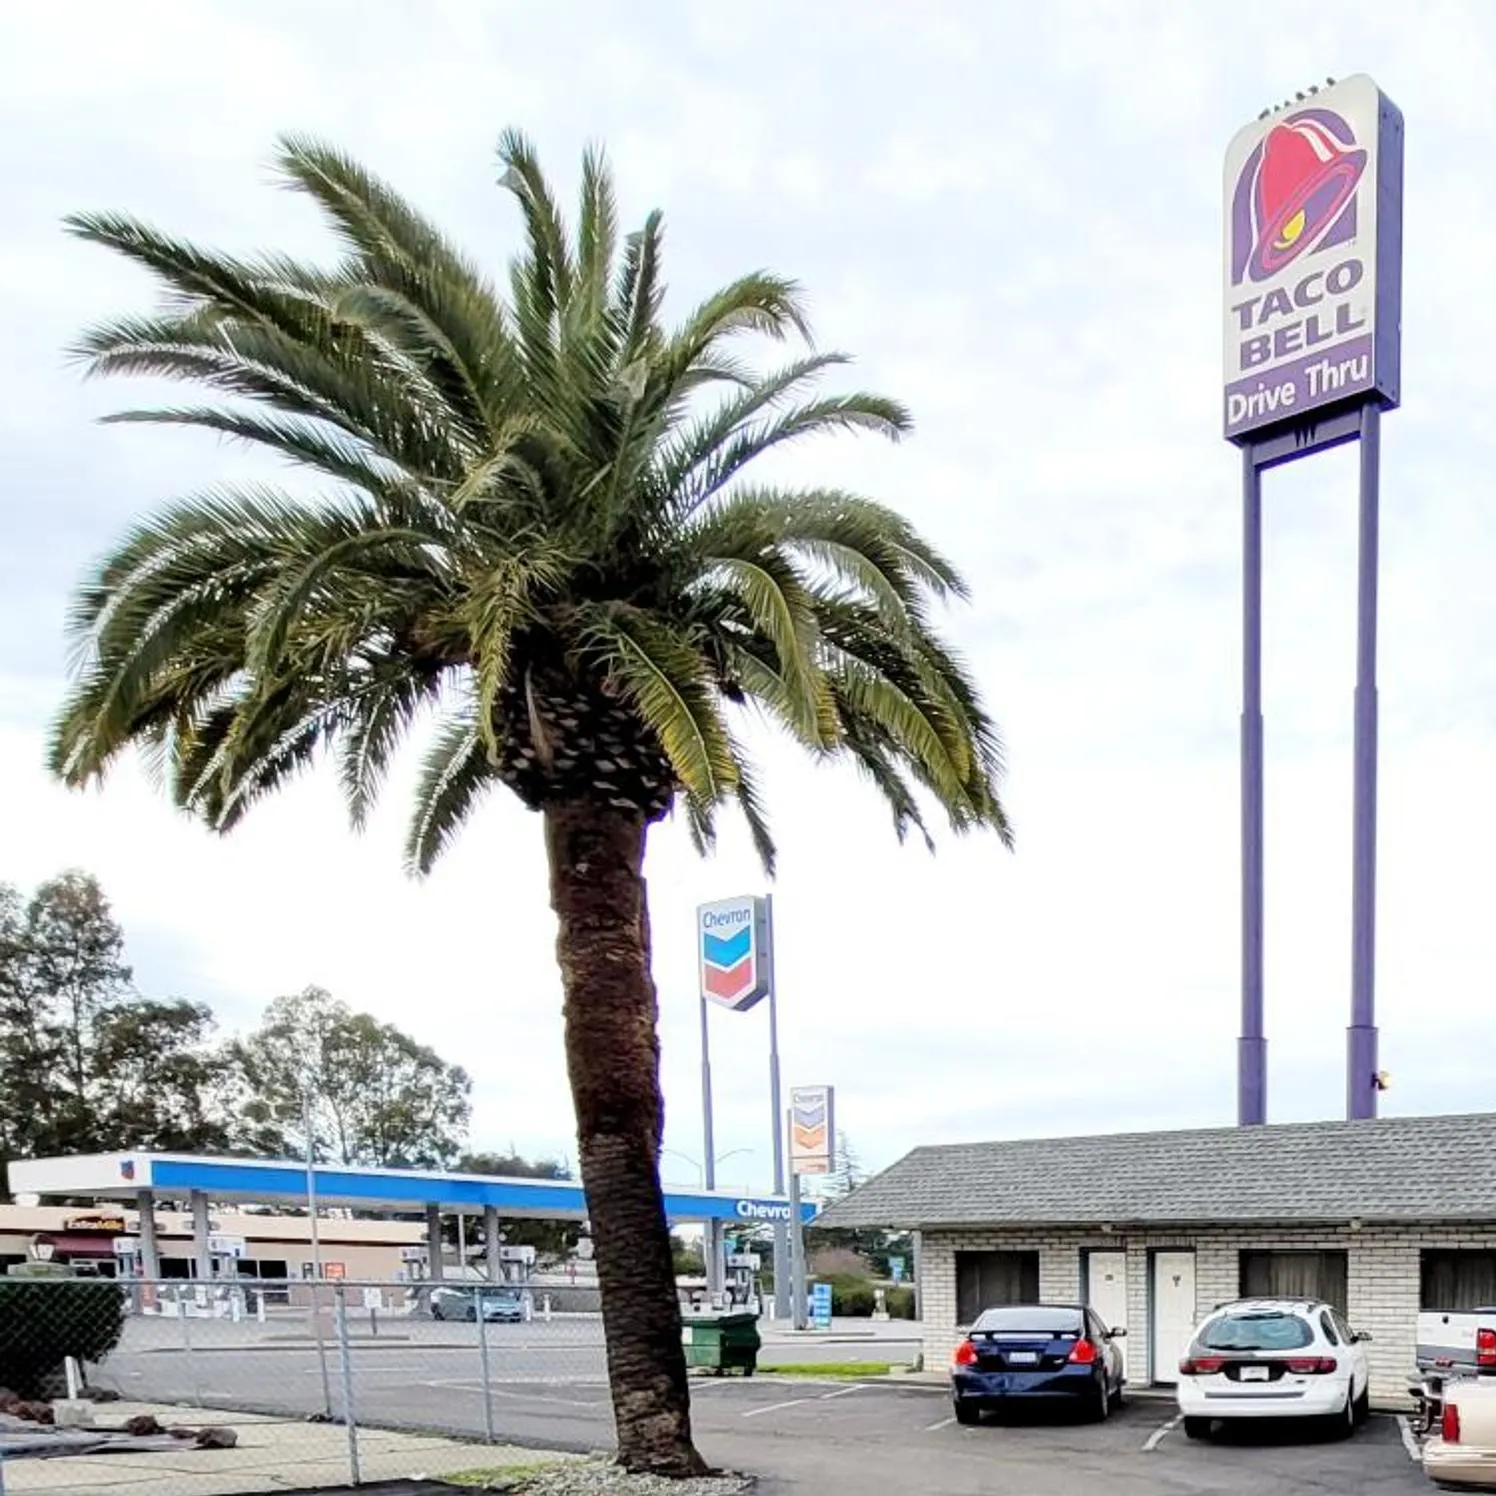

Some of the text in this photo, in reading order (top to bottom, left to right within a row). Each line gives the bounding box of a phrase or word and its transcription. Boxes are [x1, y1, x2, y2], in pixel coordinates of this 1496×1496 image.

[1231, 259, 1364, 330] TACO
[1240, 303, 1365, 371] BELL
[1228, 355, 1369, 425] Drive Thru
[703, 909, 751, 929] Chevron
[736, 1200, 791, 1219] Chevro
